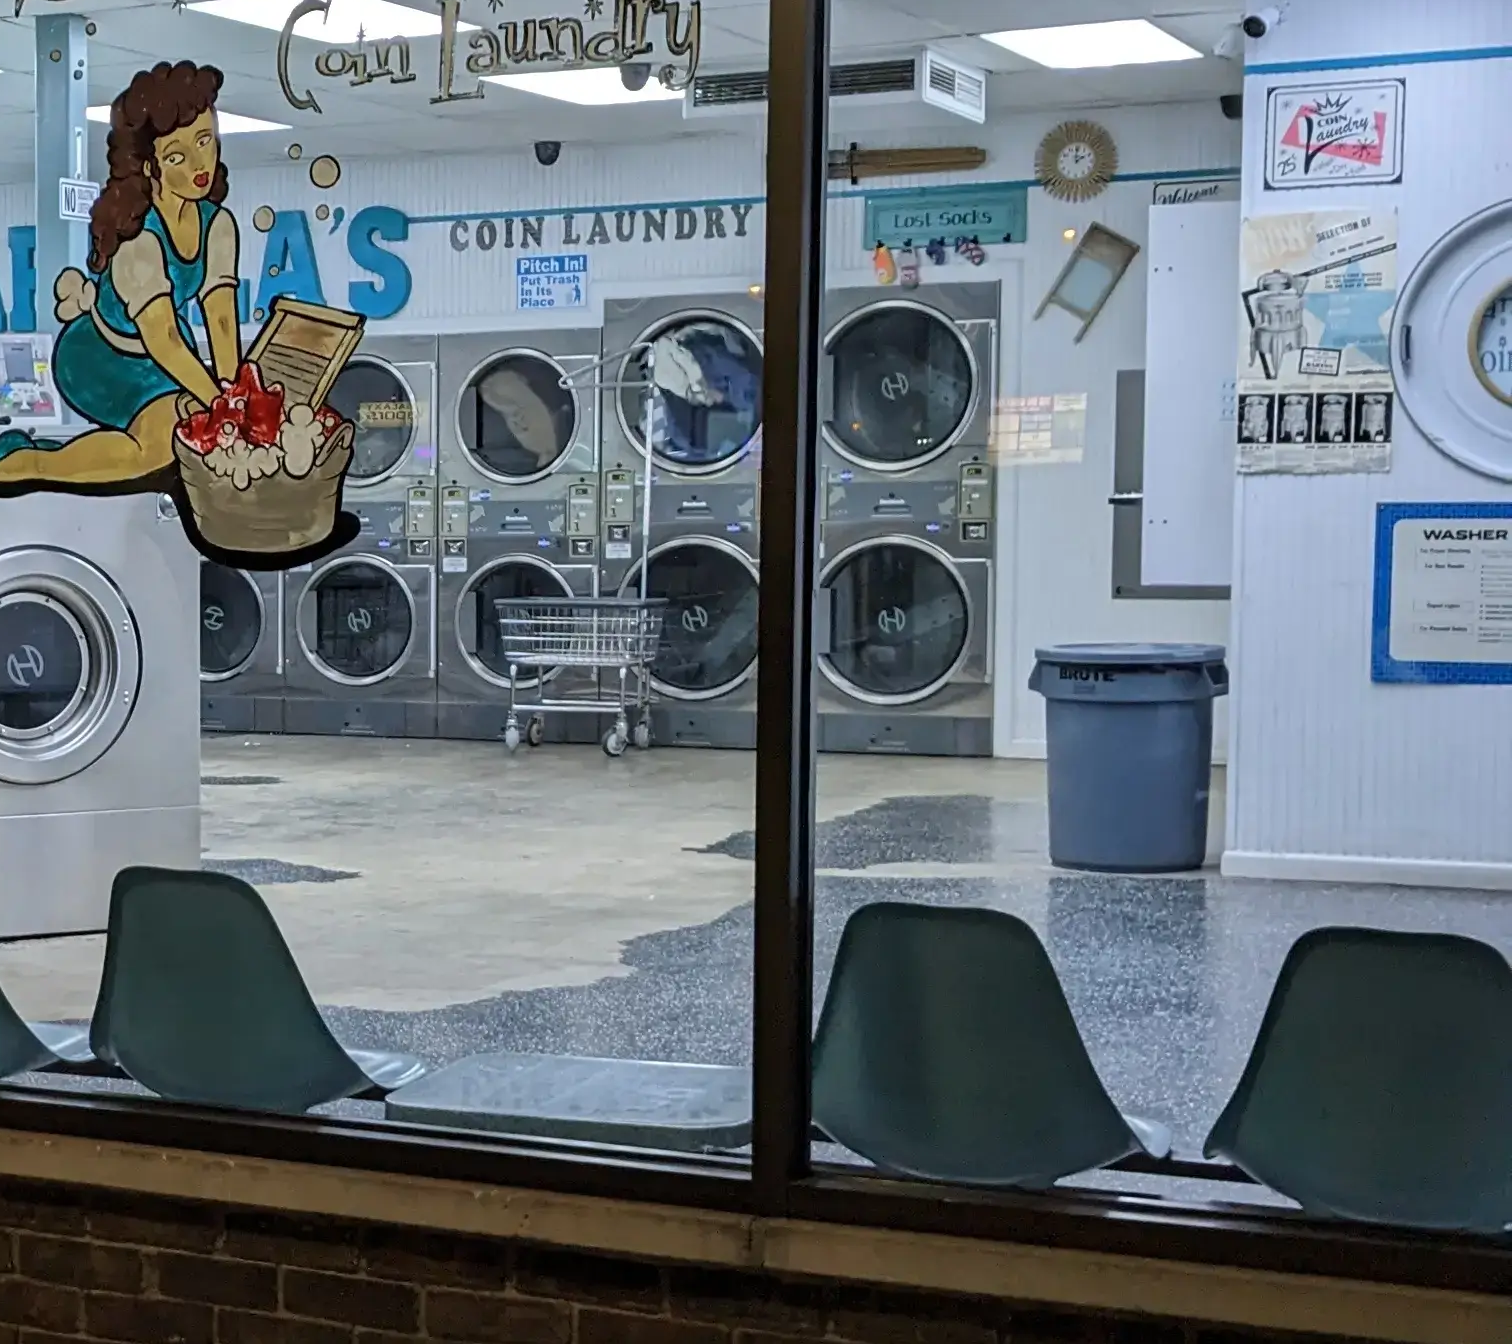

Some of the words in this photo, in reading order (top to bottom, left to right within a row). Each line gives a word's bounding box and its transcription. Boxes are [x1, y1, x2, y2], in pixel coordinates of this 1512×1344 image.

[1317, 114, 1348, 128] COIN
[65, 187, 76, 212] NO
[894, 212, 931, 229] Lost
[939, 210, 992, 228] Socks
[450, 216, 545, 251] COIN
[562, 204, 753, 244] LAUNDRY
[519, 258, 560, 274] Pitch
[564, 256, 585, 272] In!
[520, 275, 541, 286] Put
[544, 274, 580, 285] Trash
[520, 287, 533, 297] In
[536, 286, 553, 296] Its
[520, 297, 555, 308] Place
[1423, 529, 1509, 541] WASHER
